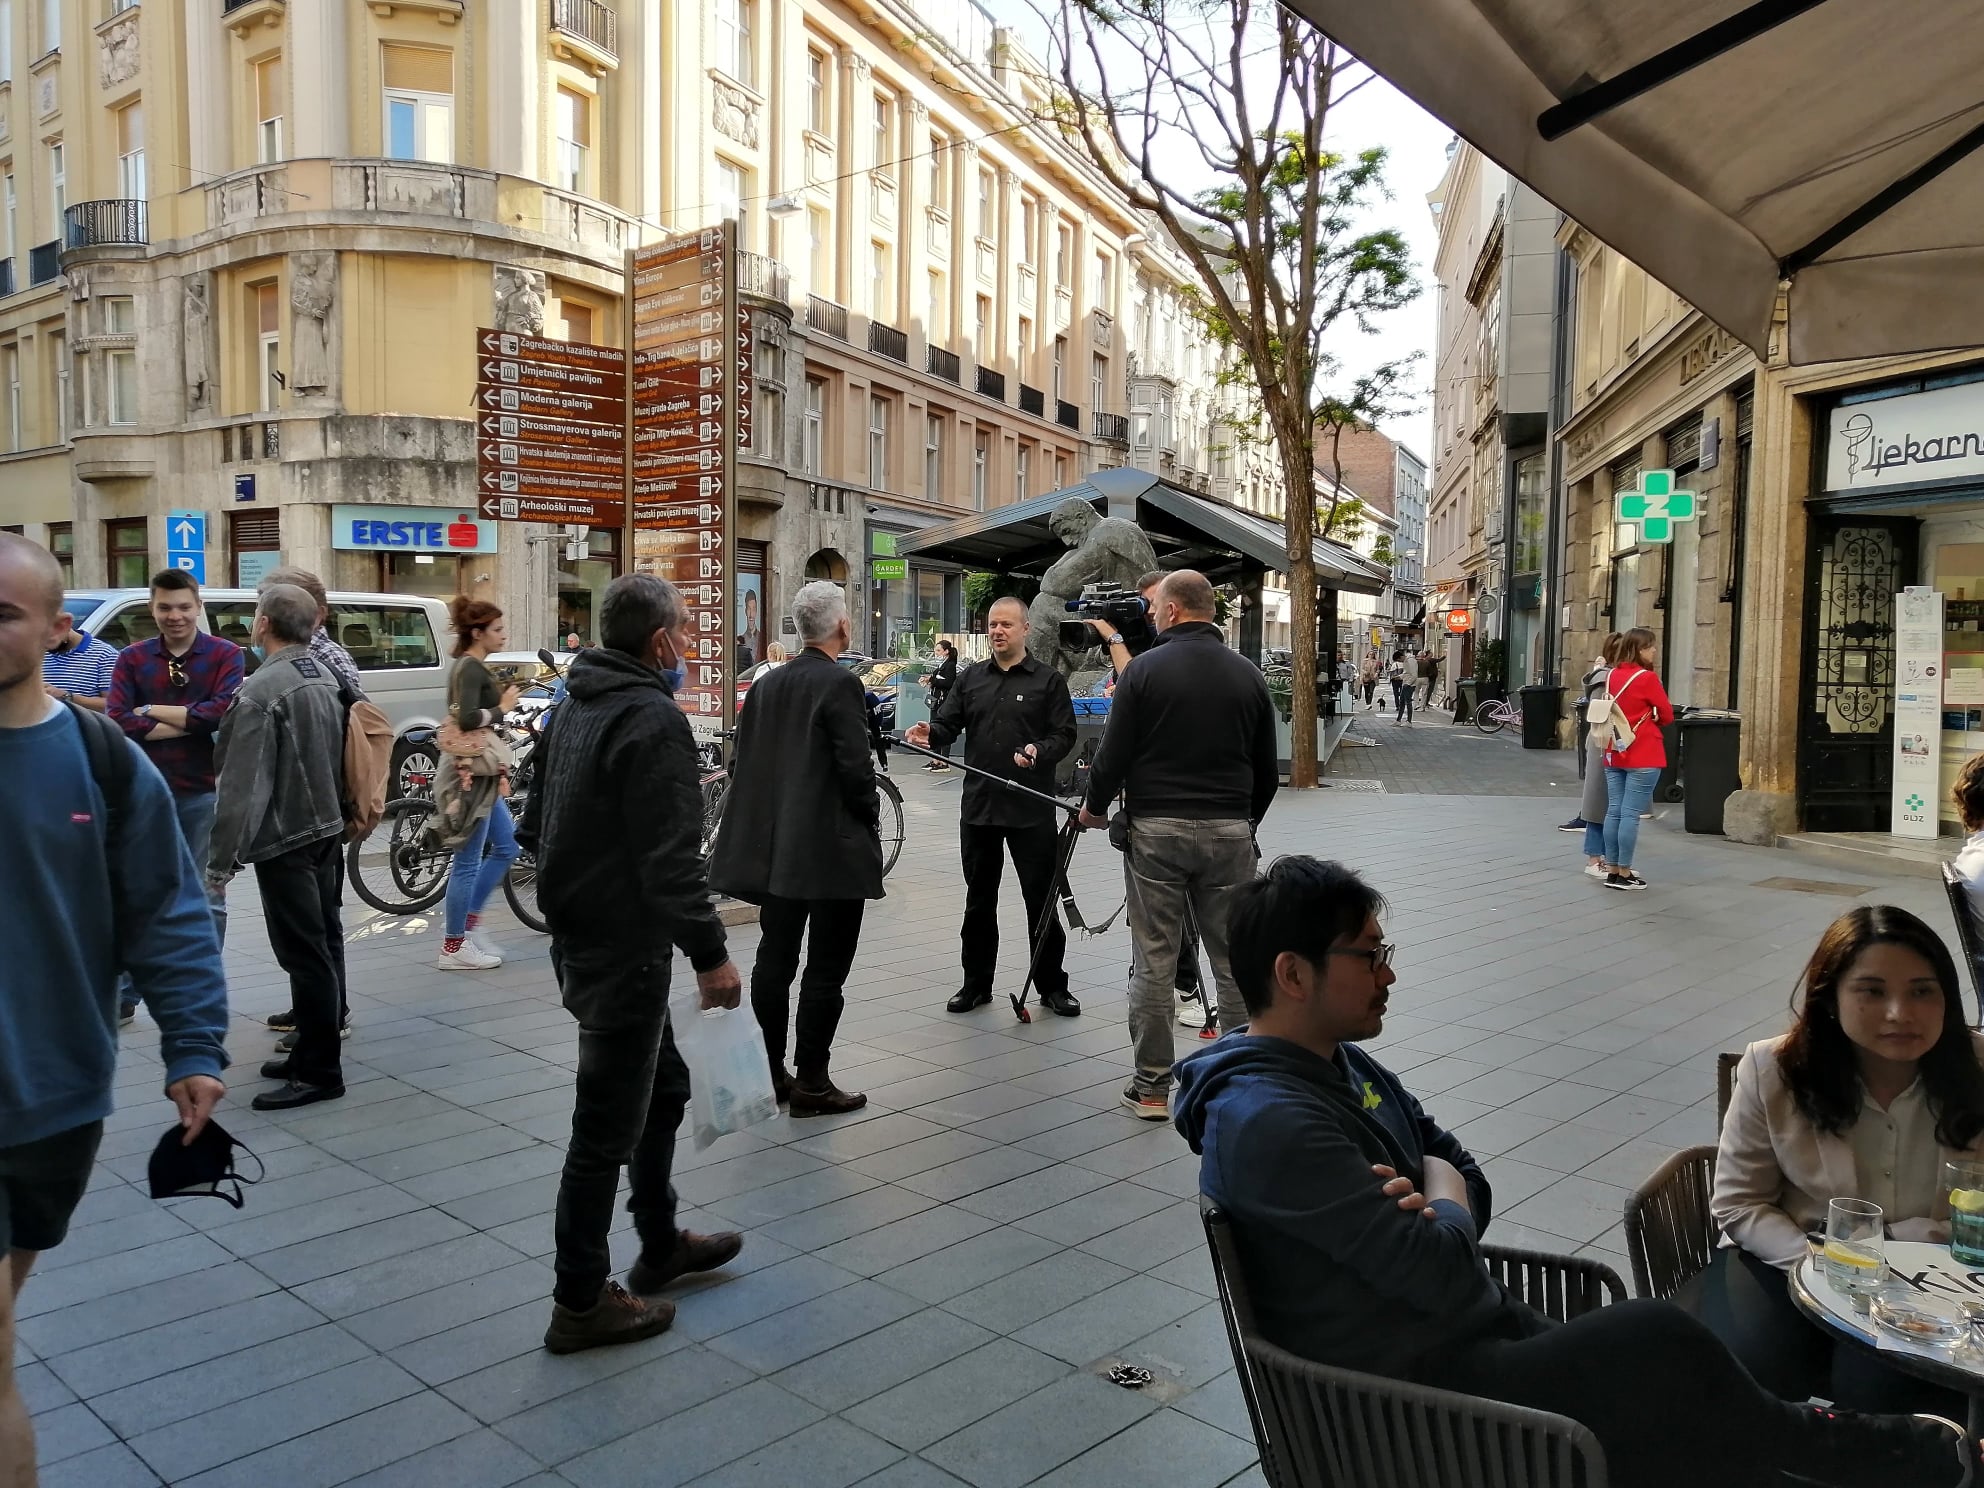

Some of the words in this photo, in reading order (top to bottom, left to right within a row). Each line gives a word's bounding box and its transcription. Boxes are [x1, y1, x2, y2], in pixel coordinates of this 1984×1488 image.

[635, 250, 651, 260] Muzej
[676, 235, 696, 248] Zagreb
[646, 272, 662, 283] Europa
[634, 301, 651, 312] Zagreb
[652, 299, 661, 308] Eye
[520, 337, 564, 352] Zagrebačko
[566, 344, 598, 356] kazalište
[600, 350, 624, 361] mladih
[656, 350, 670, 360] bana
[520, 364, 568, 379] Umjetnički
[569, 372, 602, 384] paviljon
[532, 379, 560, 388] Pavilion
[520, 392, 560, 405] Moderna
[562, 398, 592, 410] galerija
[634, 406, 650, 416] Muzej
[651, 404, 666, 415] grada
[667, 399, 690, 412] Zagreba
[520, 404, 548, 414] Modern
[549, 406, 574, 417] Gallery
[520, 419, 590, 435] Strossmayerova
[591, 427, 622, 440] galerija
[634, 432, 656, 442] Galerija
[656, 428, 670, 439] Mijo
[670, 424, 694, 436] Kovačić
[520, 431, 564, 442] Strossmayer
[565, 434, 590, 444] Gallery
[520, 446, 543, 457] Hrvatska
[544, 449, 570, 462] akademija
[571, 452, 592, 462] znanosti
[596, 454, 622, 464] umjetnosti
[1862, 432, 1984, 477] Ljekarn
[634, 457, 652, 468] Hrvatski
[634, 484, 650, 494] Atelje
[650, 480, 677, 492] Meštrović
[520, 500, 566, 512] Arheološki
[568, 505, 594, 517] muzej
[634, 509, 656, 520] Hrvatski
[656, 506, 680, 519] povijesni
[682, 505, 700, 516] muzej
[520, 512, 572, 522] Archaeological
[572, 515, 602, 523] Museum
[352, 520, 443, 546] ERSTE
[876, 564, 904, 572] GARDEN
[698, 724, 720, 736] Zagreb
